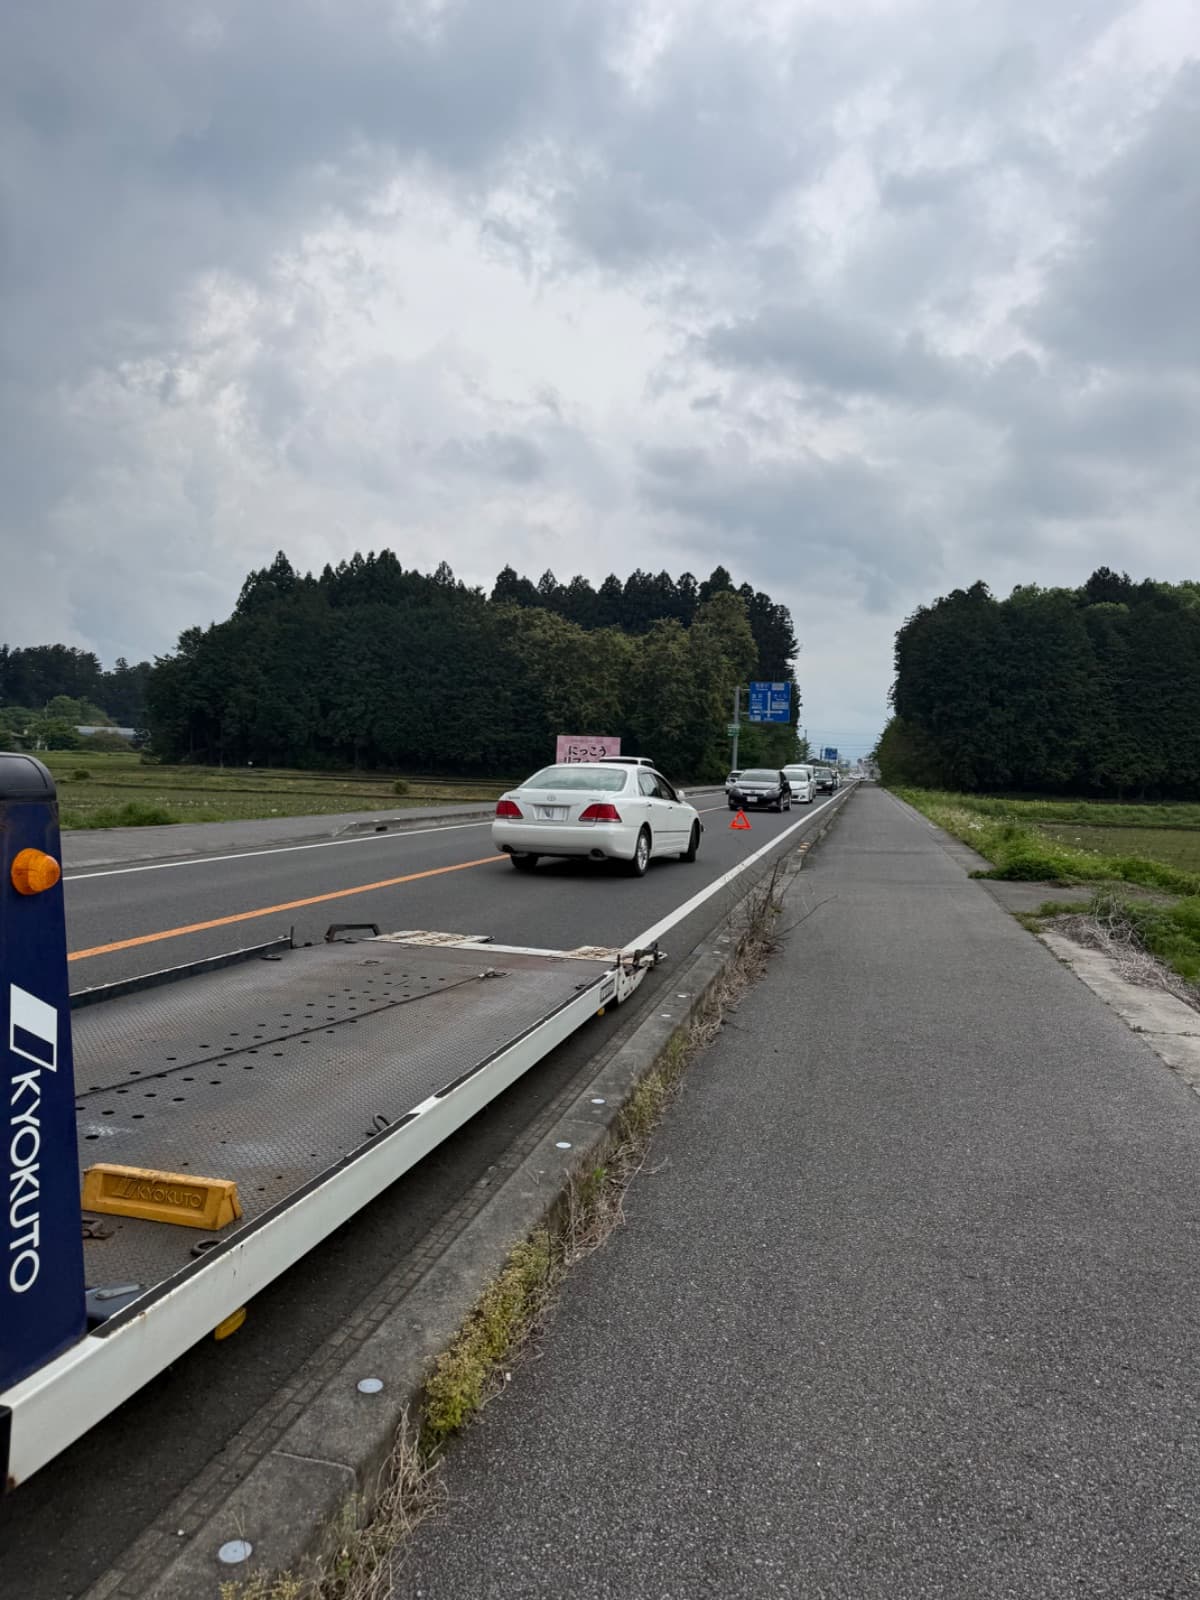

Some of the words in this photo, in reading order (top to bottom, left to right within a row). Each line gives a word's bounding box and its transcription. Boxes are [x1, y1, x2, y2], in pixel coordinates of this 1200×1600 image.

[568, 745, 607, 757] にっこう
[9, 1069, 41, 1293] KYOKUTO
[135, 1184, 203, 1209] KYOKUTO
